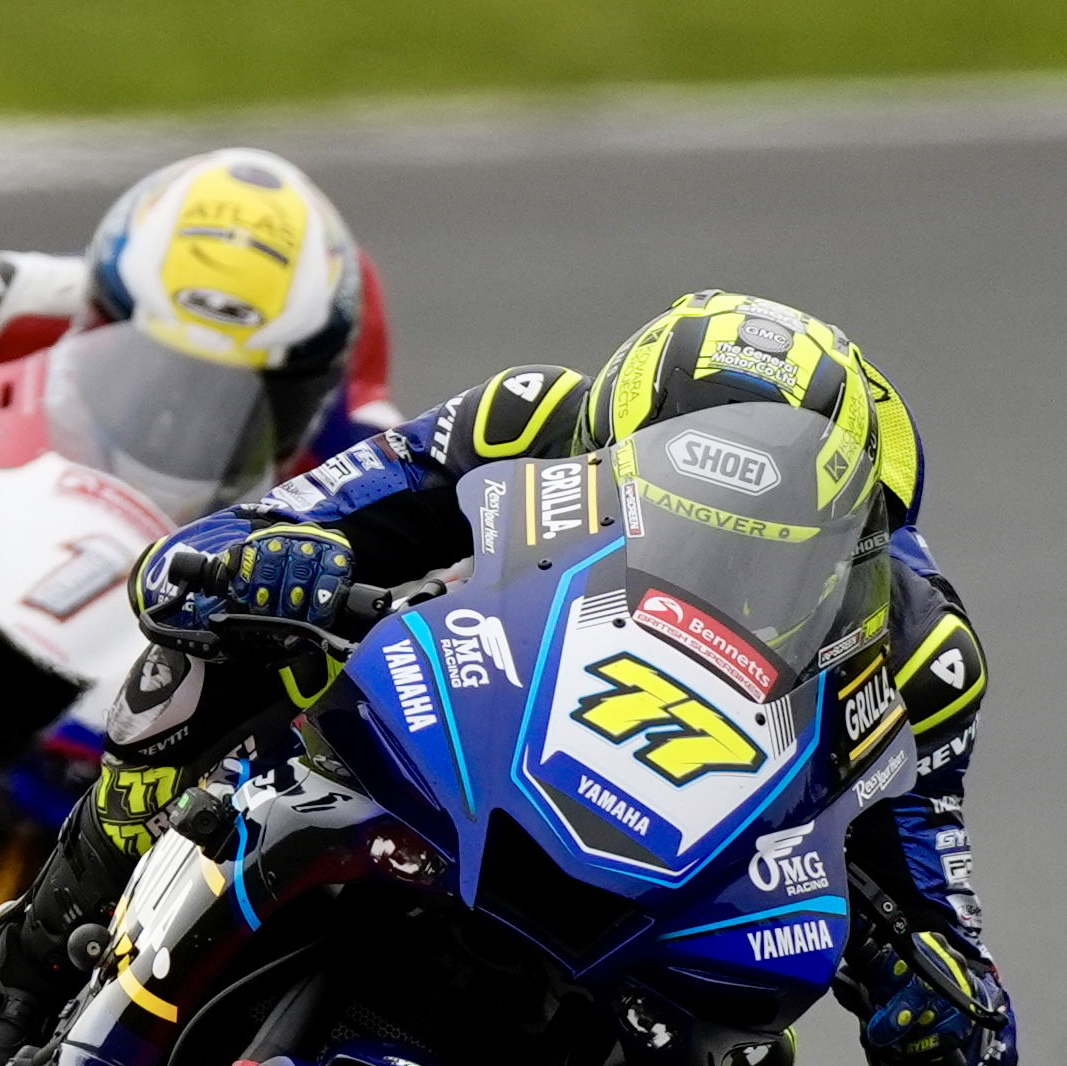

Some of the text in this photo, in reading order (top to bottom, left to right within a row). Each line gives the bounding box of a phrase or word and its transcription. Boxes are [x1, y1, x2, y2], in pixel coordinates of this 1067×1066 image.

[711, 352, 797, 387] Motor Co Ltd
[716, 341, 798, 376] The General
[683, 438, 766, 486] SHOEI
[21, 534, 132, 623] 1
[439, 639, 461, 688] RACING
[638, 613, 764, 700] BRITISH SUPERBIKES
[689, 618, 771, 688] Bennetts
[383, 640, 438, 734] YAMAHA
[572, 652, 766, 786] 77
[575, 775, 650, 838] YAMAHA
[786, 877, 829, 897] RACING
[747, 920, 833, 961] YAMAHA
